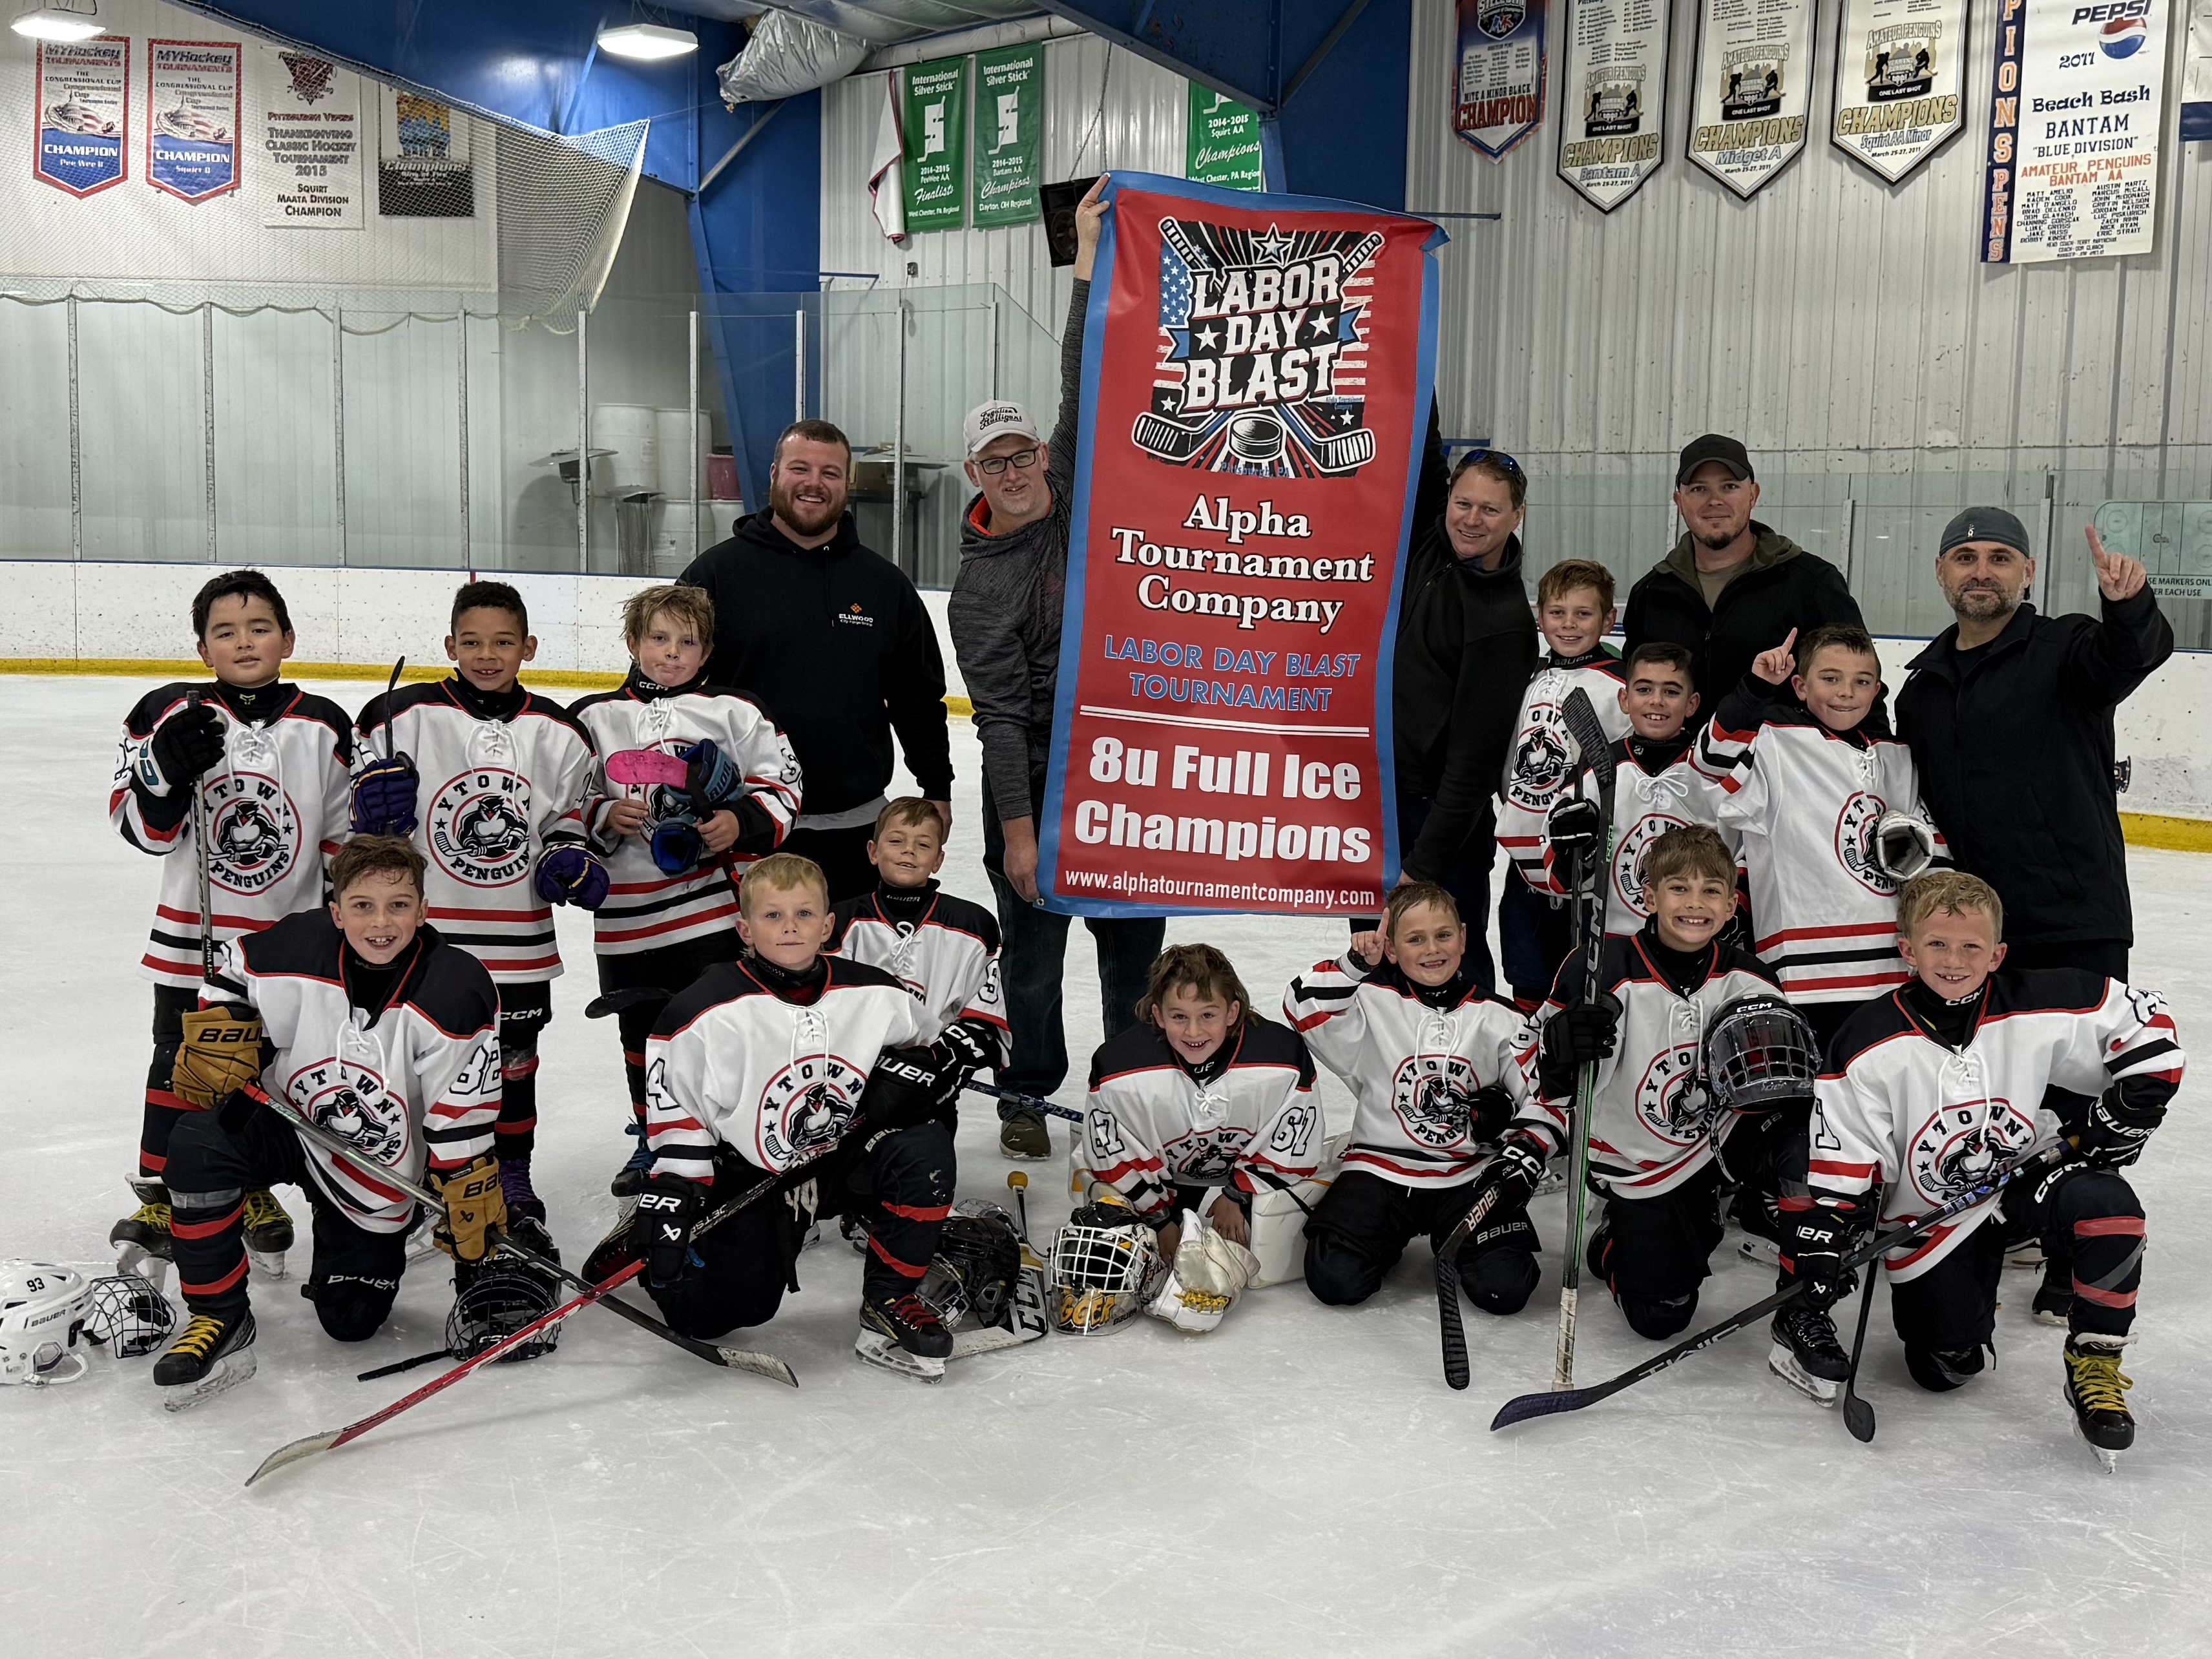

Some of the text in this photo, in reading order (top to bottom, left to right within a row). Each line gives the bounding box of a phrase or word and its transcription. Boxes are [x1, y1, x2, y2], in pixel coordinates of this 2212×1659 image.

[2072, 0, 2152, 25] PEPSI
[1866, 20, 1942, 50] AMATEUR PENGUINS
[157, 50, 233, 65] MYHockey
[983, 57, 1034, 76] International
[1721, 43, 1789, 70] AMATEUR PENGUINS
[2059, 52, 2095, 69] 2011
[912, 68, 959, 85] International
[914, 81, 955, 96] Silver Stick
[986, 70, 1030, 87] Silver Stick
[1585, 64, 1647, 90] AMATEUR PENGUINS
[1487, 87, 1507, 98] MINOR
[1508, 84, 1530, 95] BLACK
[2032, 85, 2150, 112] Beach Bash
[1208, 114, 1249, 128] 2014-2015
[1457, 94, 1537, 131] CHAMPION
[1837, 94, 1958, 136] CHAMPIONS
[1211, 125, 1244, 139] Squirt AA
[1693, 115, 1805, 152] CHAMPIONS
[2045, 114, 2130, 139] BANTAM
[44, 144, 118, 157] CHAMPION
[1563, 133, 1659, 169] CHAMPIONS
[1861, 129, 1932, 149] Squirt AA Minor
[156, 150, 230, 163] CHAMPION
[273, 152, 350, 164] TOURNAMENT
[1195, 140, 1260, 169] Champions
[1715, 146, 1781, 165] Midget A
[2021, 154, 2151, 178] AMATEUR PENGUINS
[1011, 165, 1023, 174] AA
[1231, 171, 1240, 180] PA
[1580, 163, 1641, 182] Bantam A
[2049, 170, 2123, 187] BANTAM AA
[297, 184, 328, 193] SQUIRT
[310, 195, 349, 204] DIVISION
[914, 184, 954, 206] Finalists
[981, 176, 1031, 200] Champions
[285, 205, 342, 217] CHAMPION
[1010, 198, 1032, 209] Regional
[1988, 169, 2009, 262] PENS
[1191, 257, 1342, 319] LABOR
[1223, 307, 1307, 355] DAY
[1184, 342, 1341, 411] BLAST
[1183, 495, 1311, 543] Alpha
[1111, 527, 1375, 581] Tournament
[2158, 578, 2194, 586] MARKERS
[1138, 574, 1344, 633] Company
[839, 614, 873, 623] ELLWOOD
[1104, 635, 1361, 678] LABOR DAY BLAST
[639, 681, 669, 691] CCM
[1130, 673, 1332, 711] TOURNAMENT
[1089, 736, 1361, 800] 8u Full Ice
[1075, 800, 1371, 862] Champions
[210, 851, 289, 888] PENGUINS
[1065, 870, 1375, 910] www.alphatournamentcompany.com
[499, 1008, 543, 1021] CCM
[1736, 1003, 1773, 1013] CCM
[295, 1065, 396, 1114] YTOWN
[763, 1063, 864, 1111] YTOWN
[2095, 1097, 2156, 1137] BAUER
[1271, 1107, 1316, 1156] 61
[1918, 1106, 2024, 1153] YTOWN
[2034, 1161, 2087, 1204] CCM
[1466, 1185, 1501, 1231] BAUER
[1477, 1222, 1528, 1244] BAUER
[26, 1277, 45, 1293] 93
[30, 1308, 67, 1327] BAUER
